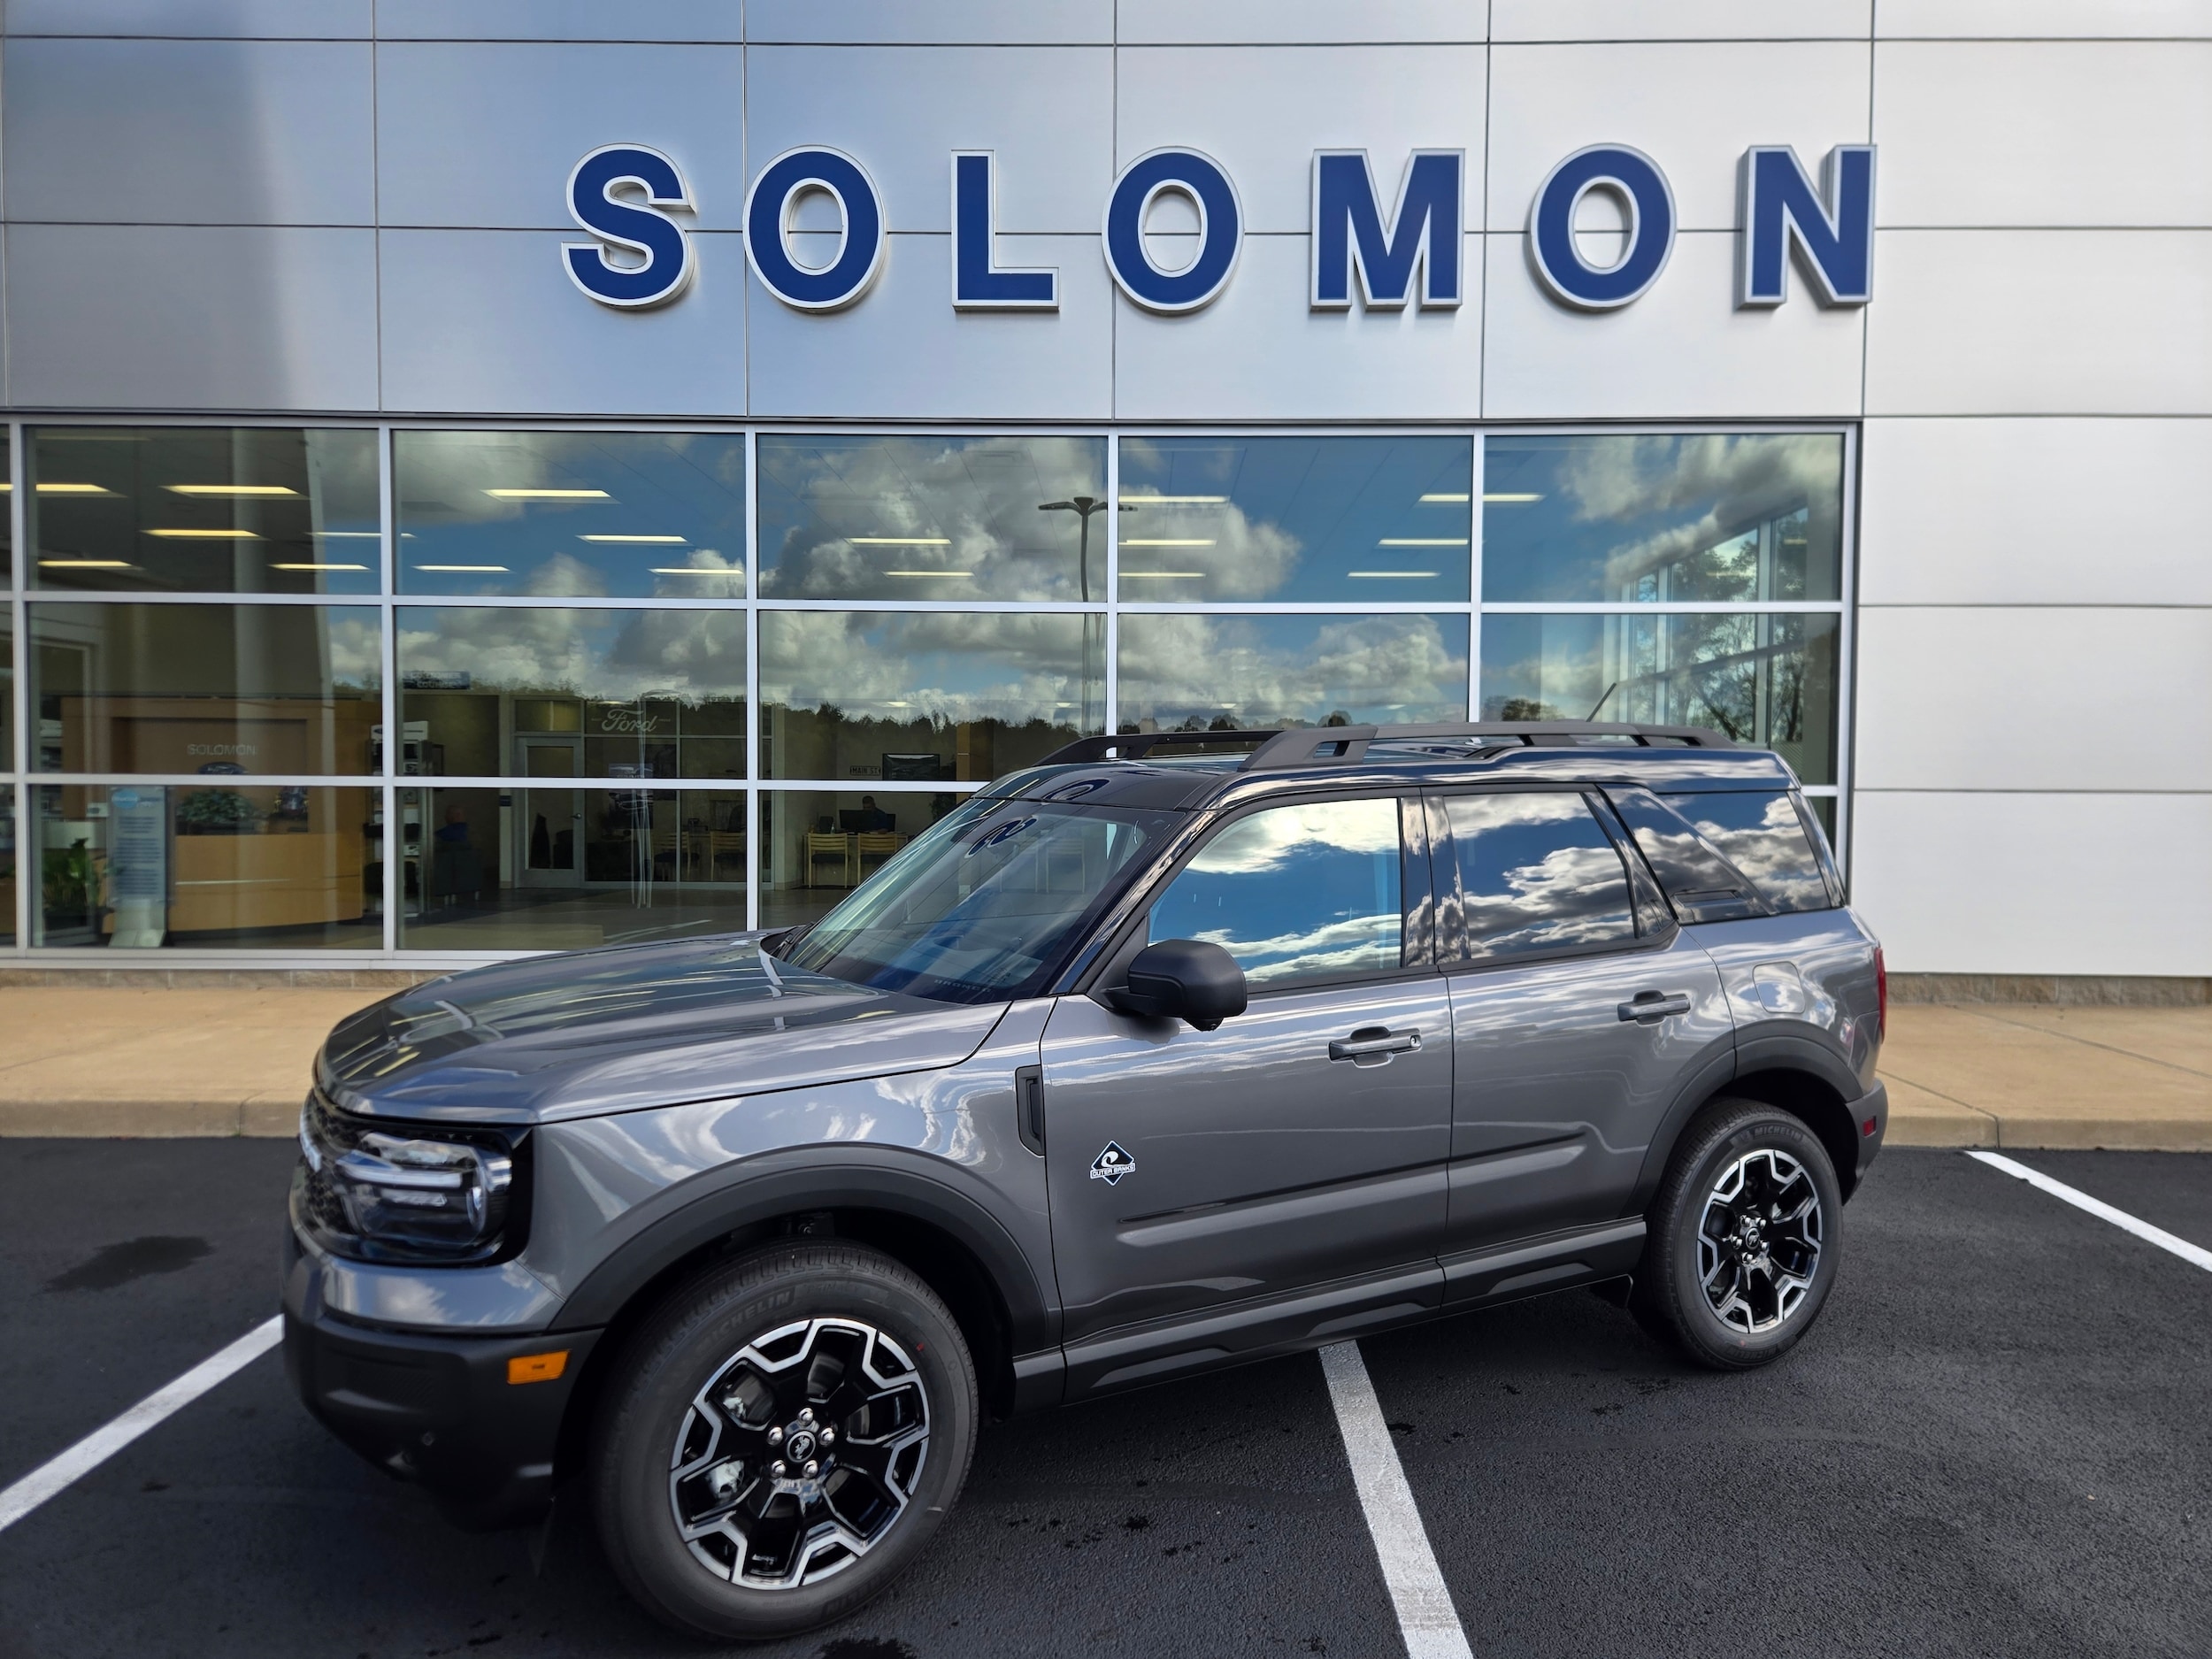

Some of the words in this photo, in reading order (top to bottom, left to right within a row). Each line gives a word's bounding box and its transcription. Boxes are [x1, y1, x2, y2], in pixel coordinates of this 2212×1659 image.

[561, 142, 1877, 313] SOLOMON
[602, 708, 658, 732] Ford
[187, 743, 255, 756] SOLOMON
[1755, 1125, 1803, 1141] MICHELIN
[1114, 1164, 1134, 1174] BANKS
[695, 1291, 791, 1352] MICHELIN
